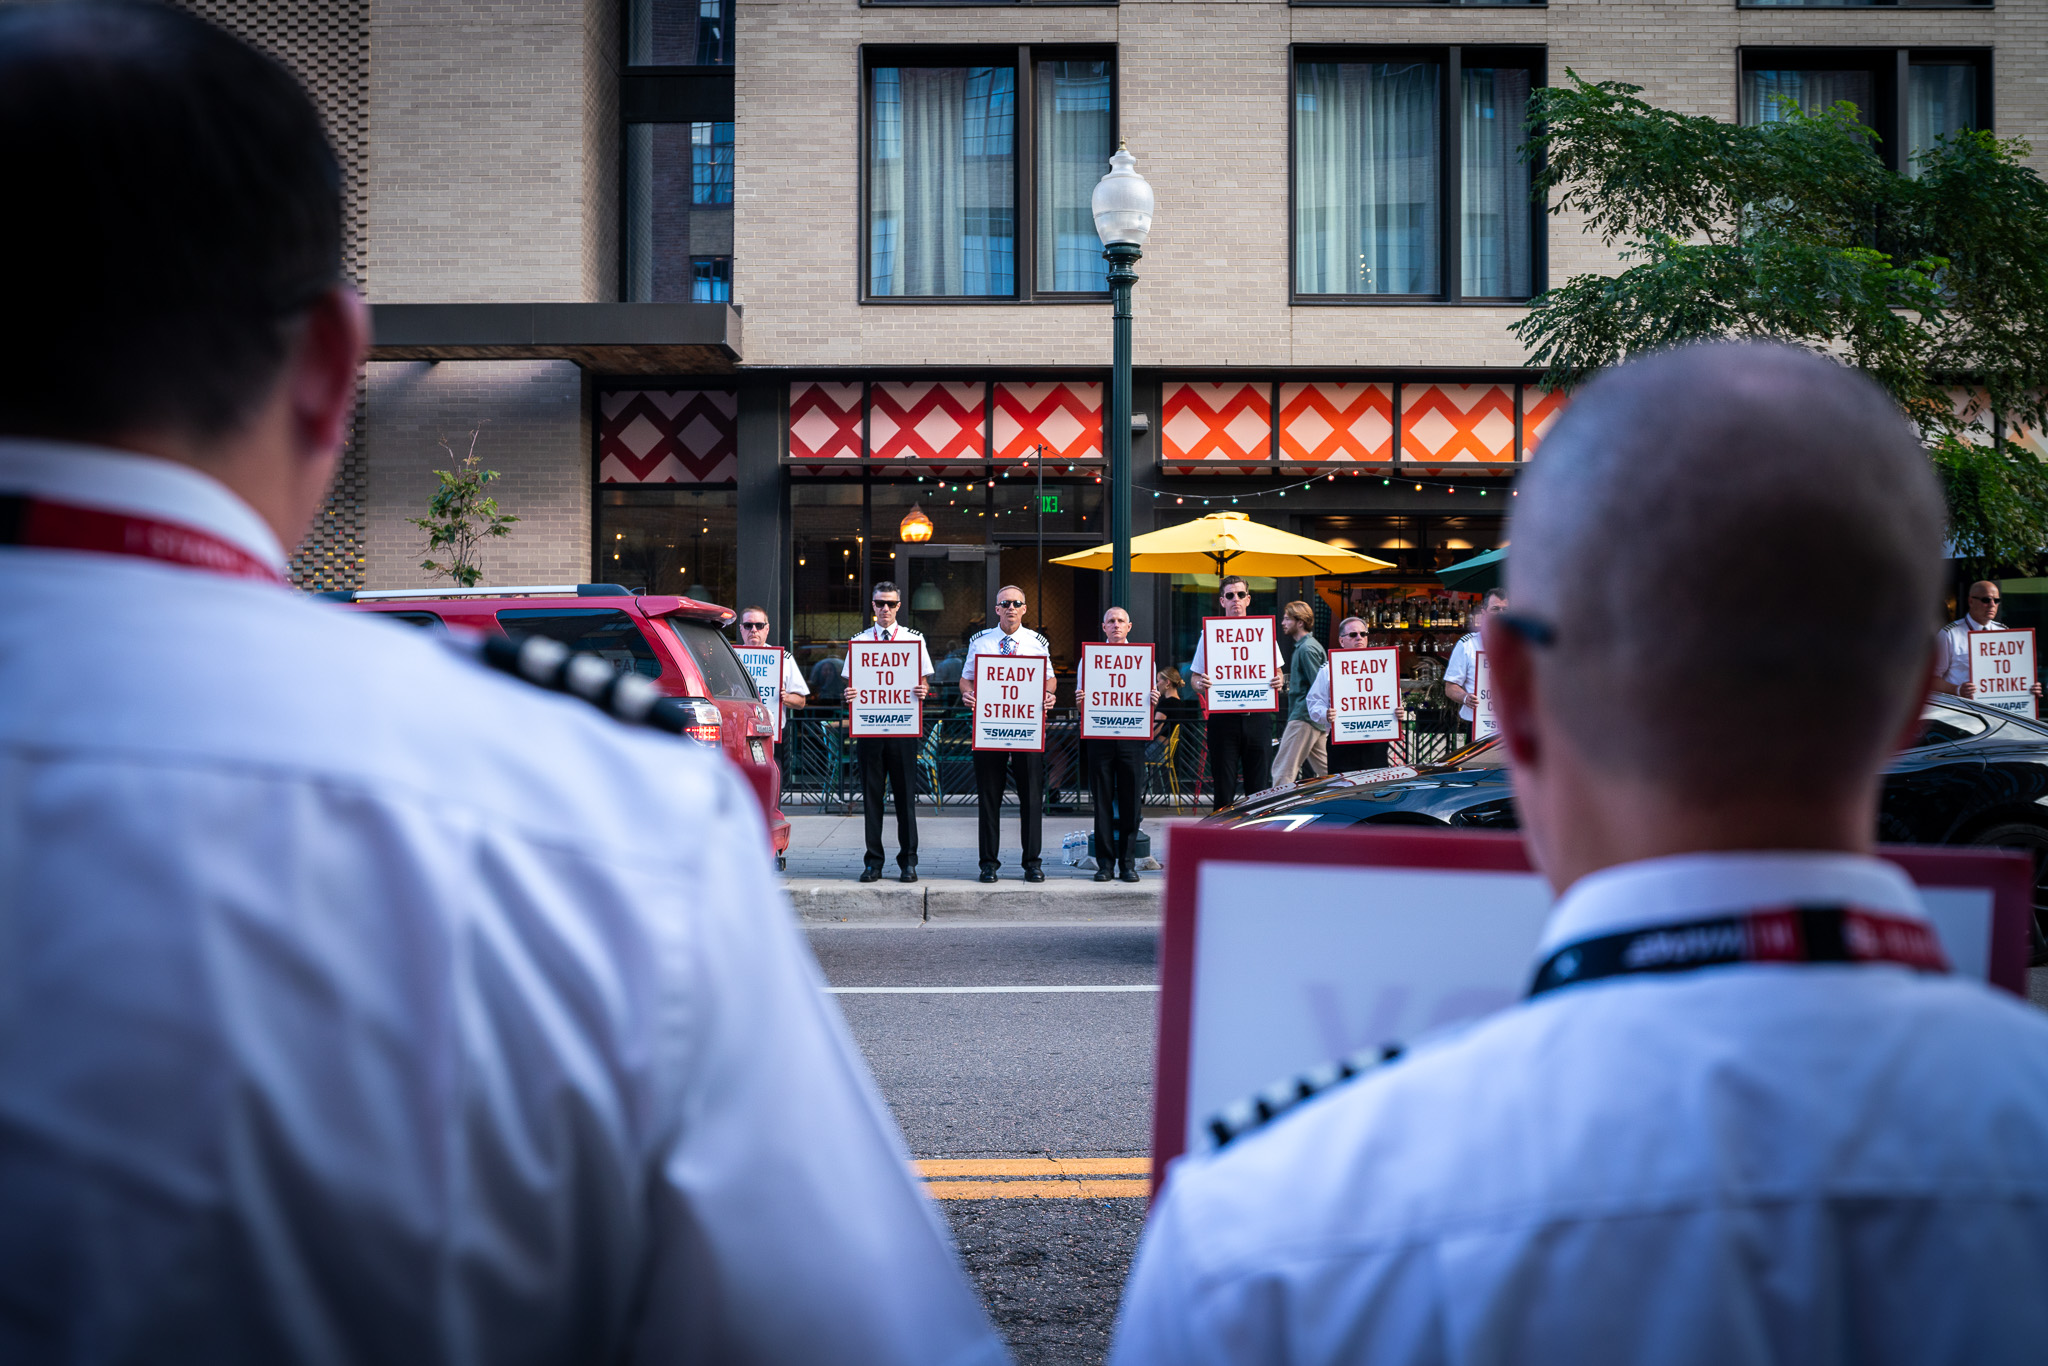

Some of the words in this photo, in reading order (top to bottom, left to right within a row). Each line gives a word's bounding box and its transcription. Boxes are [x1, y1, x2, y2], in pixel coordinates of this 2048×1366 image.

[1216, 627, 1265, 643] READY
[1230, 646, 1249, 661] TO
[1980, 640, 2025, 657] READY
[740, 653, 775, 665] OITING
[861, 652, 911, 667] READY
[1094, 654, 1143, 670] READY
[1341, 658, 1388, 675] READY
[1993, 659, 2011, 674] TO
[746, 666, 768, 677] URE
[876, 671, 894, 686] TO
[986, 666, 1036, 682] READY
[1215, 664, 1267, 680] STRIKE
[1108, 673, 1127, 688] TO
[1355, 677, 1373, 693] TO
[1979, 676, 2028, 693] STRIKE
[859, 689, 911, 704] STRIKE
[1001, 685, 1019, 700] TO
[1091, 691, 1143, 707] STRIKE
[1224, 689, 1261, 699] SWAPA
[983, 703, 1035, 719] STRIKE
[1340, 695, 1391, 712] STRIKE
[868, 714, 905, 724] SWAPA
[1099, 716, 1136, 726] SWAPA
[1349, 720, 1385, 730] SWAPA
[991, 728, 1028, 738] SWAPA
